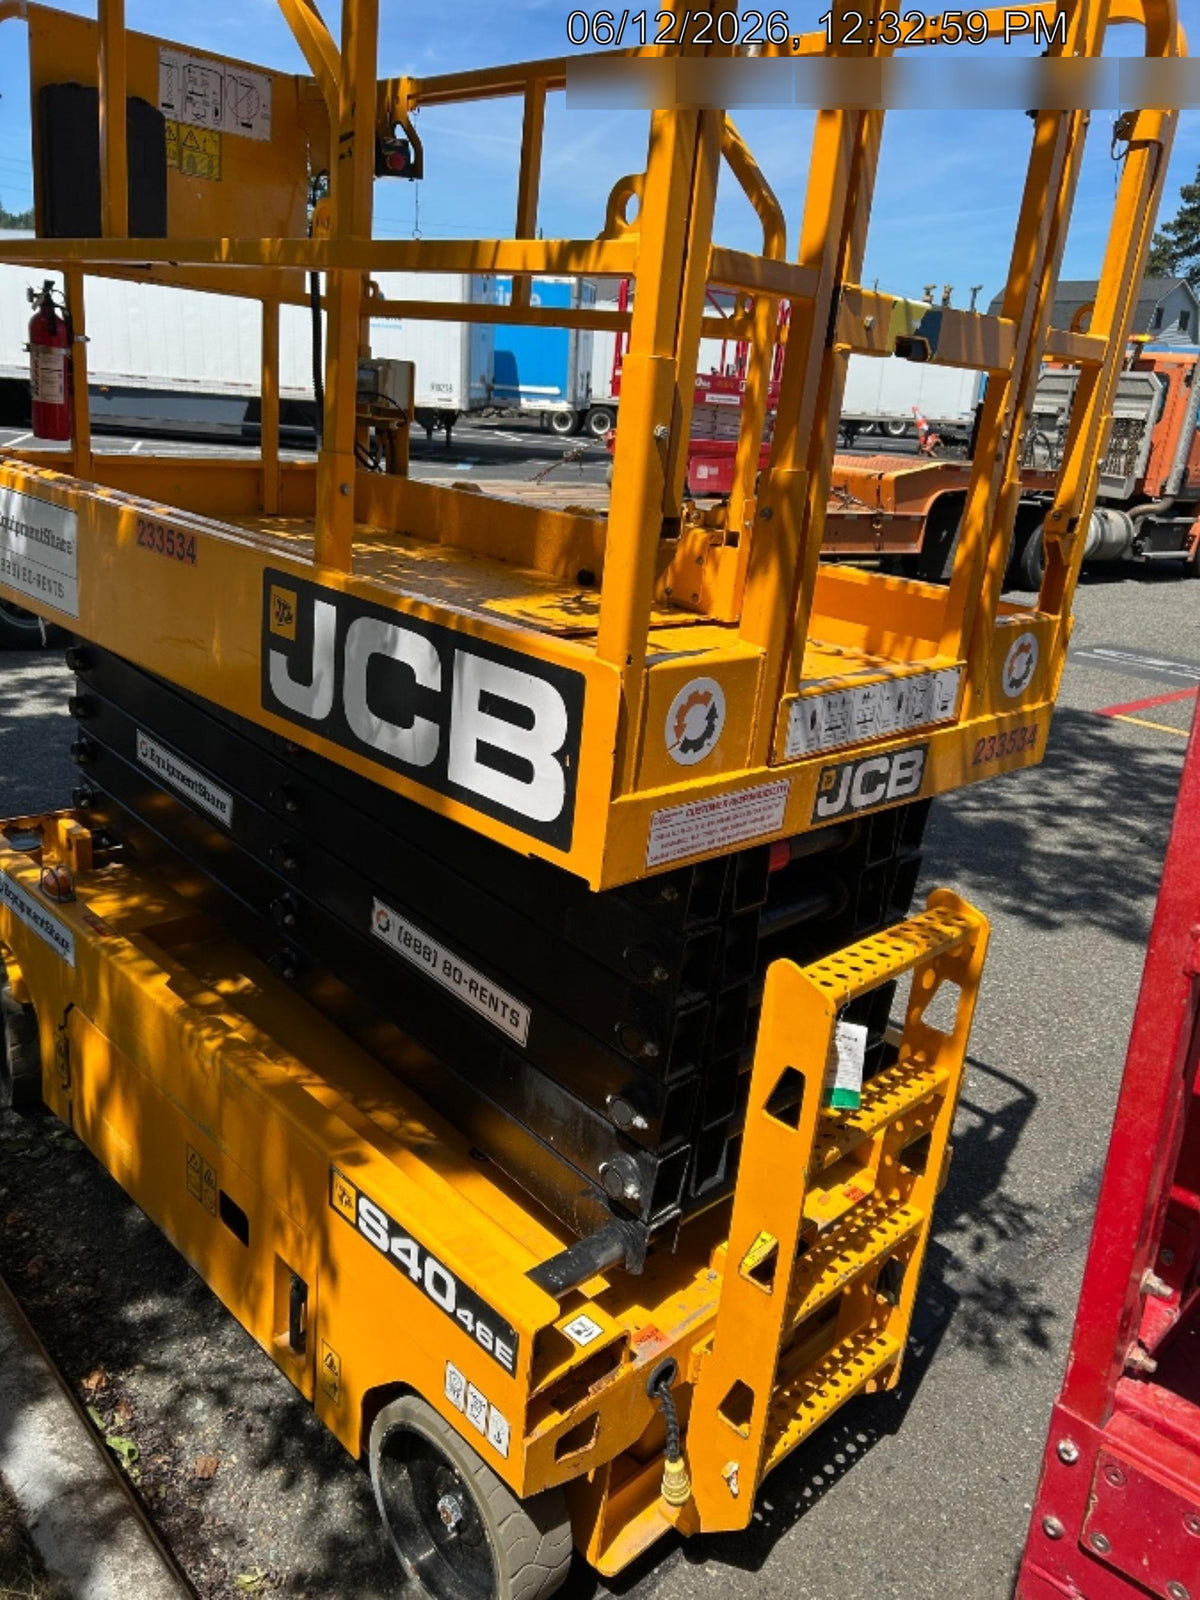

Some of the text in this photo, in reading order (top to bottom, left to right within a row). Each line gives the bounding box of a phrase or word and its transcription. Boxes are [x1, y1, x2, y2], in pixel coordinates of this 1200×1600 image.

[0, 514, 73, 555] quipmentShare
[136, 519, 197, 565] 233534
[269, 599, 568, 822] JCB
[971, 722, 1040, 765] 233534
[150, 747, 227, 814] EquipmentShare
[817, 749, 924, 817] JCB
[397, 925, 521, 1029] (888) 80-RENTS
